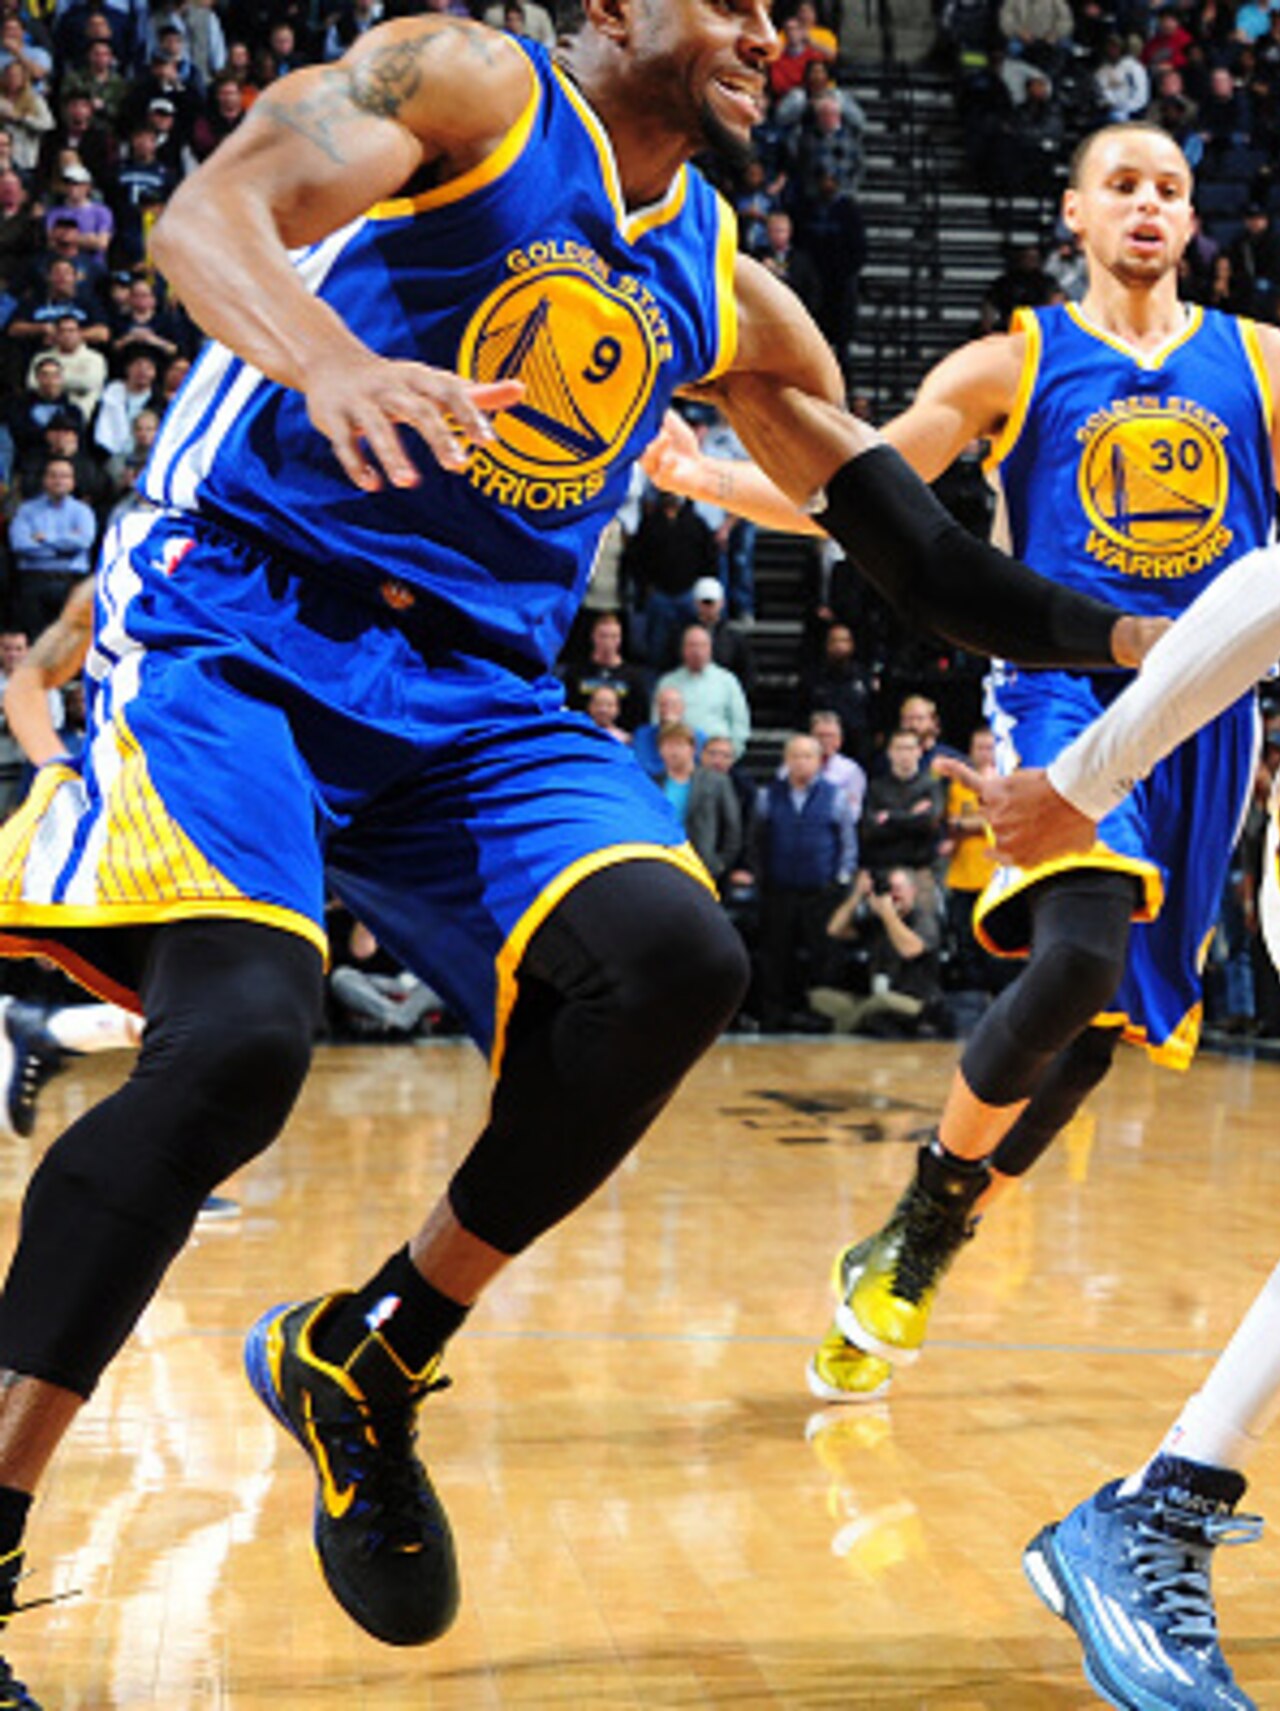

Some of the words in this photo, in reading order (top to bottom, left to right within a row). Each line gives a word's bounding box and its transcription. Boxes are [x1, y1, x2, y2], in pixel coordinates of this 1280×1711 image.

[507, 239, 612, 282] GOLDEN
[619, 274, 674, 363] STATE
[582, 335, 622, 384] 9
[448, 424, 608, 511] RRIORS
[1150, 438, 1203, 474] 30
[1084, 524, 1234, 579] WARRIORS
